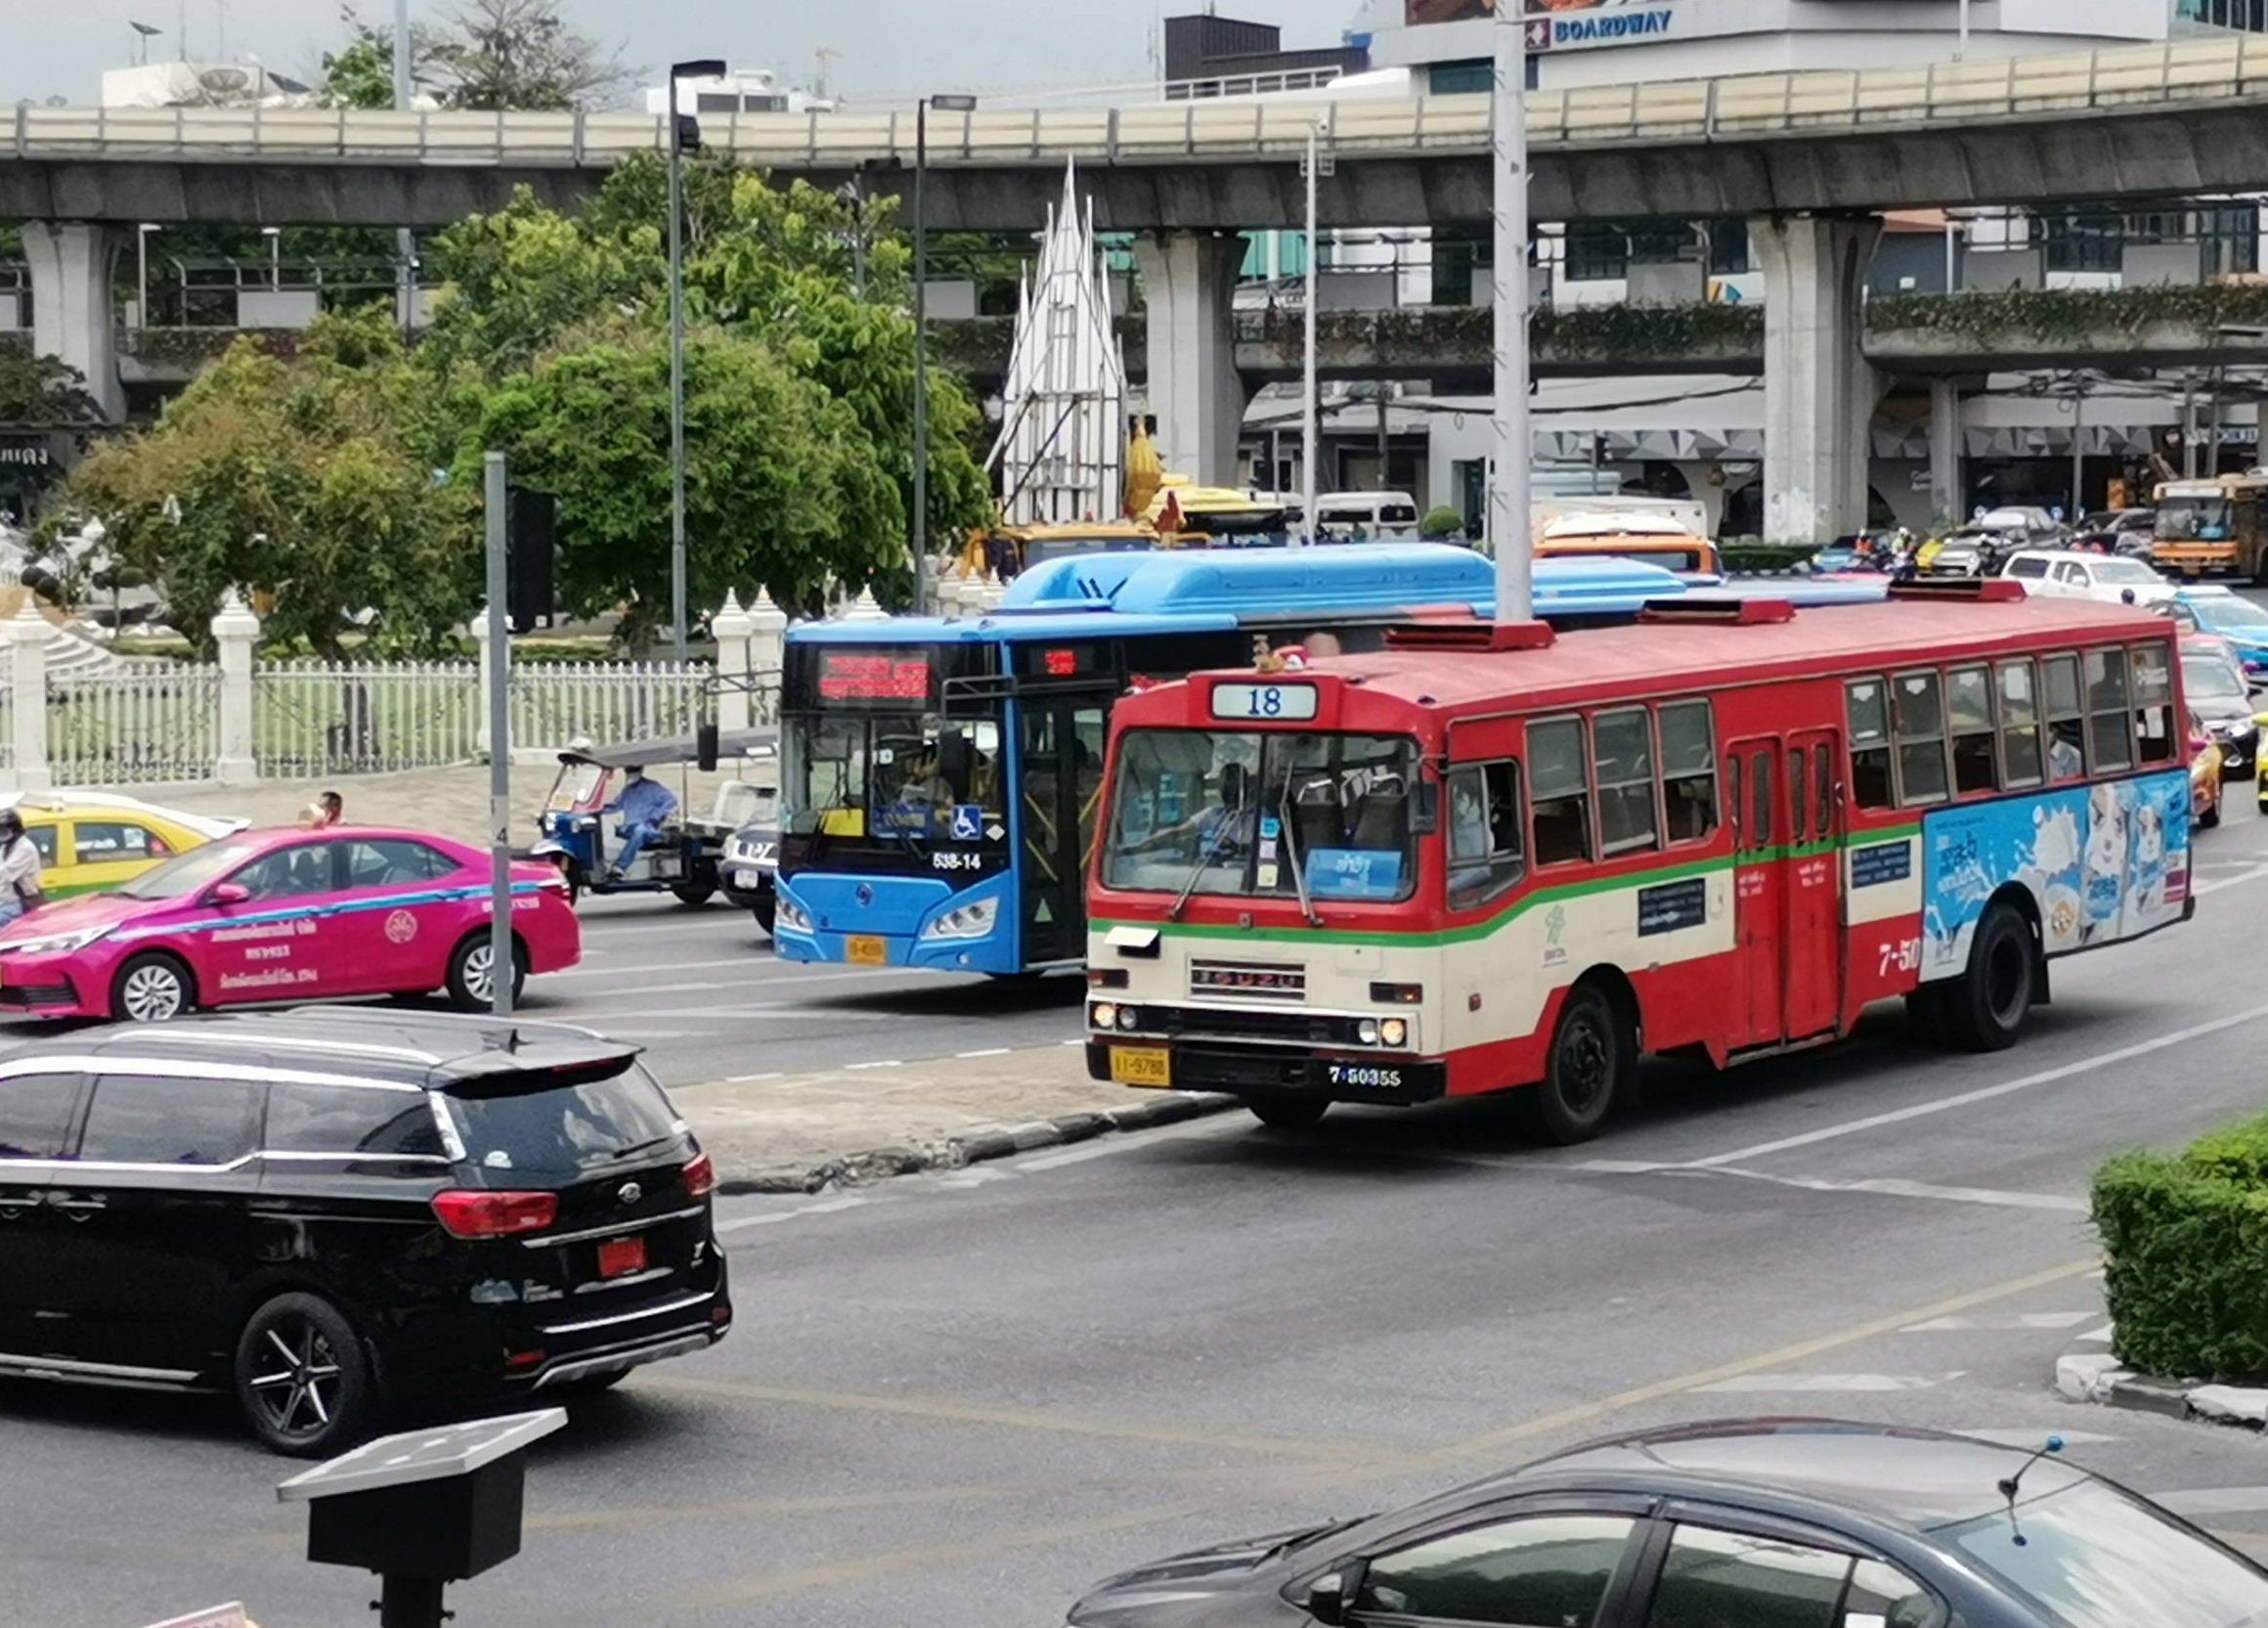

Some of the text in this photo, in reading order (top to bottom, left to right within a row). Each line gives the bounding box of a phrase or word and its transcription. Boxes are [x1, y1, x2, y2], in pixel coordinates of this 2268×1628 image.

[1555, 10, 1673, 43] BOARDWAY
[1247, 686, 1282, 717] 18
[497, 827, 508, 844] 4
